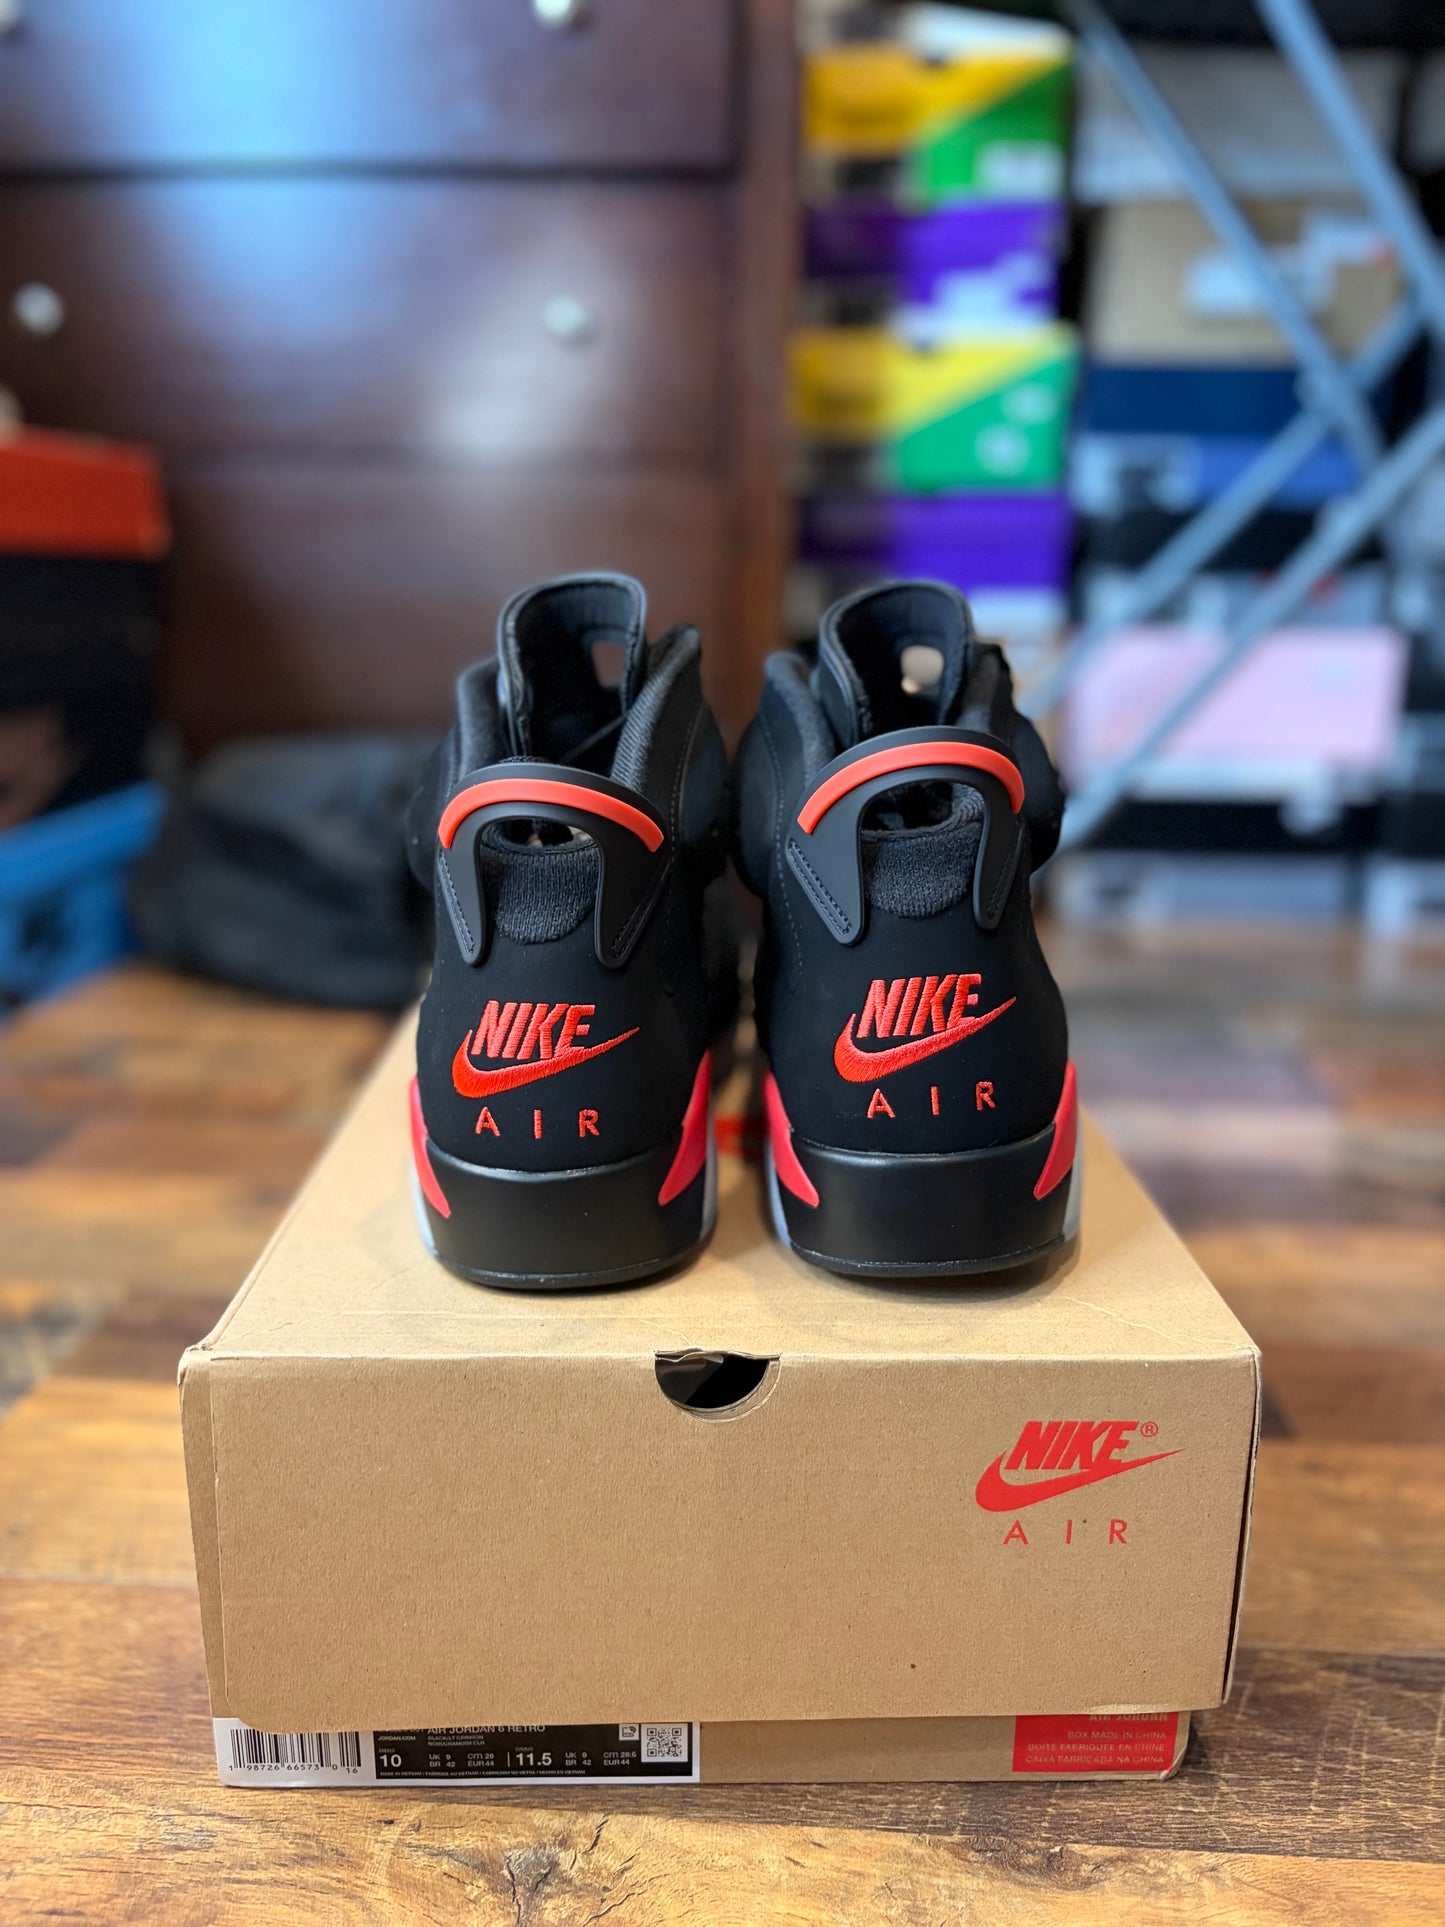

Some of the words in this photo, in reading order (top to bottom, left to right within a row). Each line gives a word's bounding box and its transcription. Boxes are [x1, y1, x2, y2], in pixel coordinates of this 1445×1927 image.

[856, 973, 982, 1038] NIKE
[470, 1000, 595, 1060] NIKE
[867, 1081, 996, 1119] AIR
[475, 1106, 600, 1139] AIR
[1003, 1420, 1139, 1471] NIKE
[1002, 1518, 1128, 1546] AIR
[449, 1726, 496, 1734] JORDAN
[1067, 1731, 1088, 1739] BOX
[1091, 1731, 1119, 1739] MADE
[1135, 1731, 1166, 1739] CHINA
[1118, 1743, 1132, 1751] EN
[379, 1753, 402, 1768] 10
[485, 1759, 495, 1767] 44
[515, 1752, 553, 1767] 11.5
[603, 1758, 620, 1766] EUR
[620, 1758, 630, 1766] 44
[1134, 1755, 1164, 1763] CHINA
[286, 1763, 320, 1771] 66573
